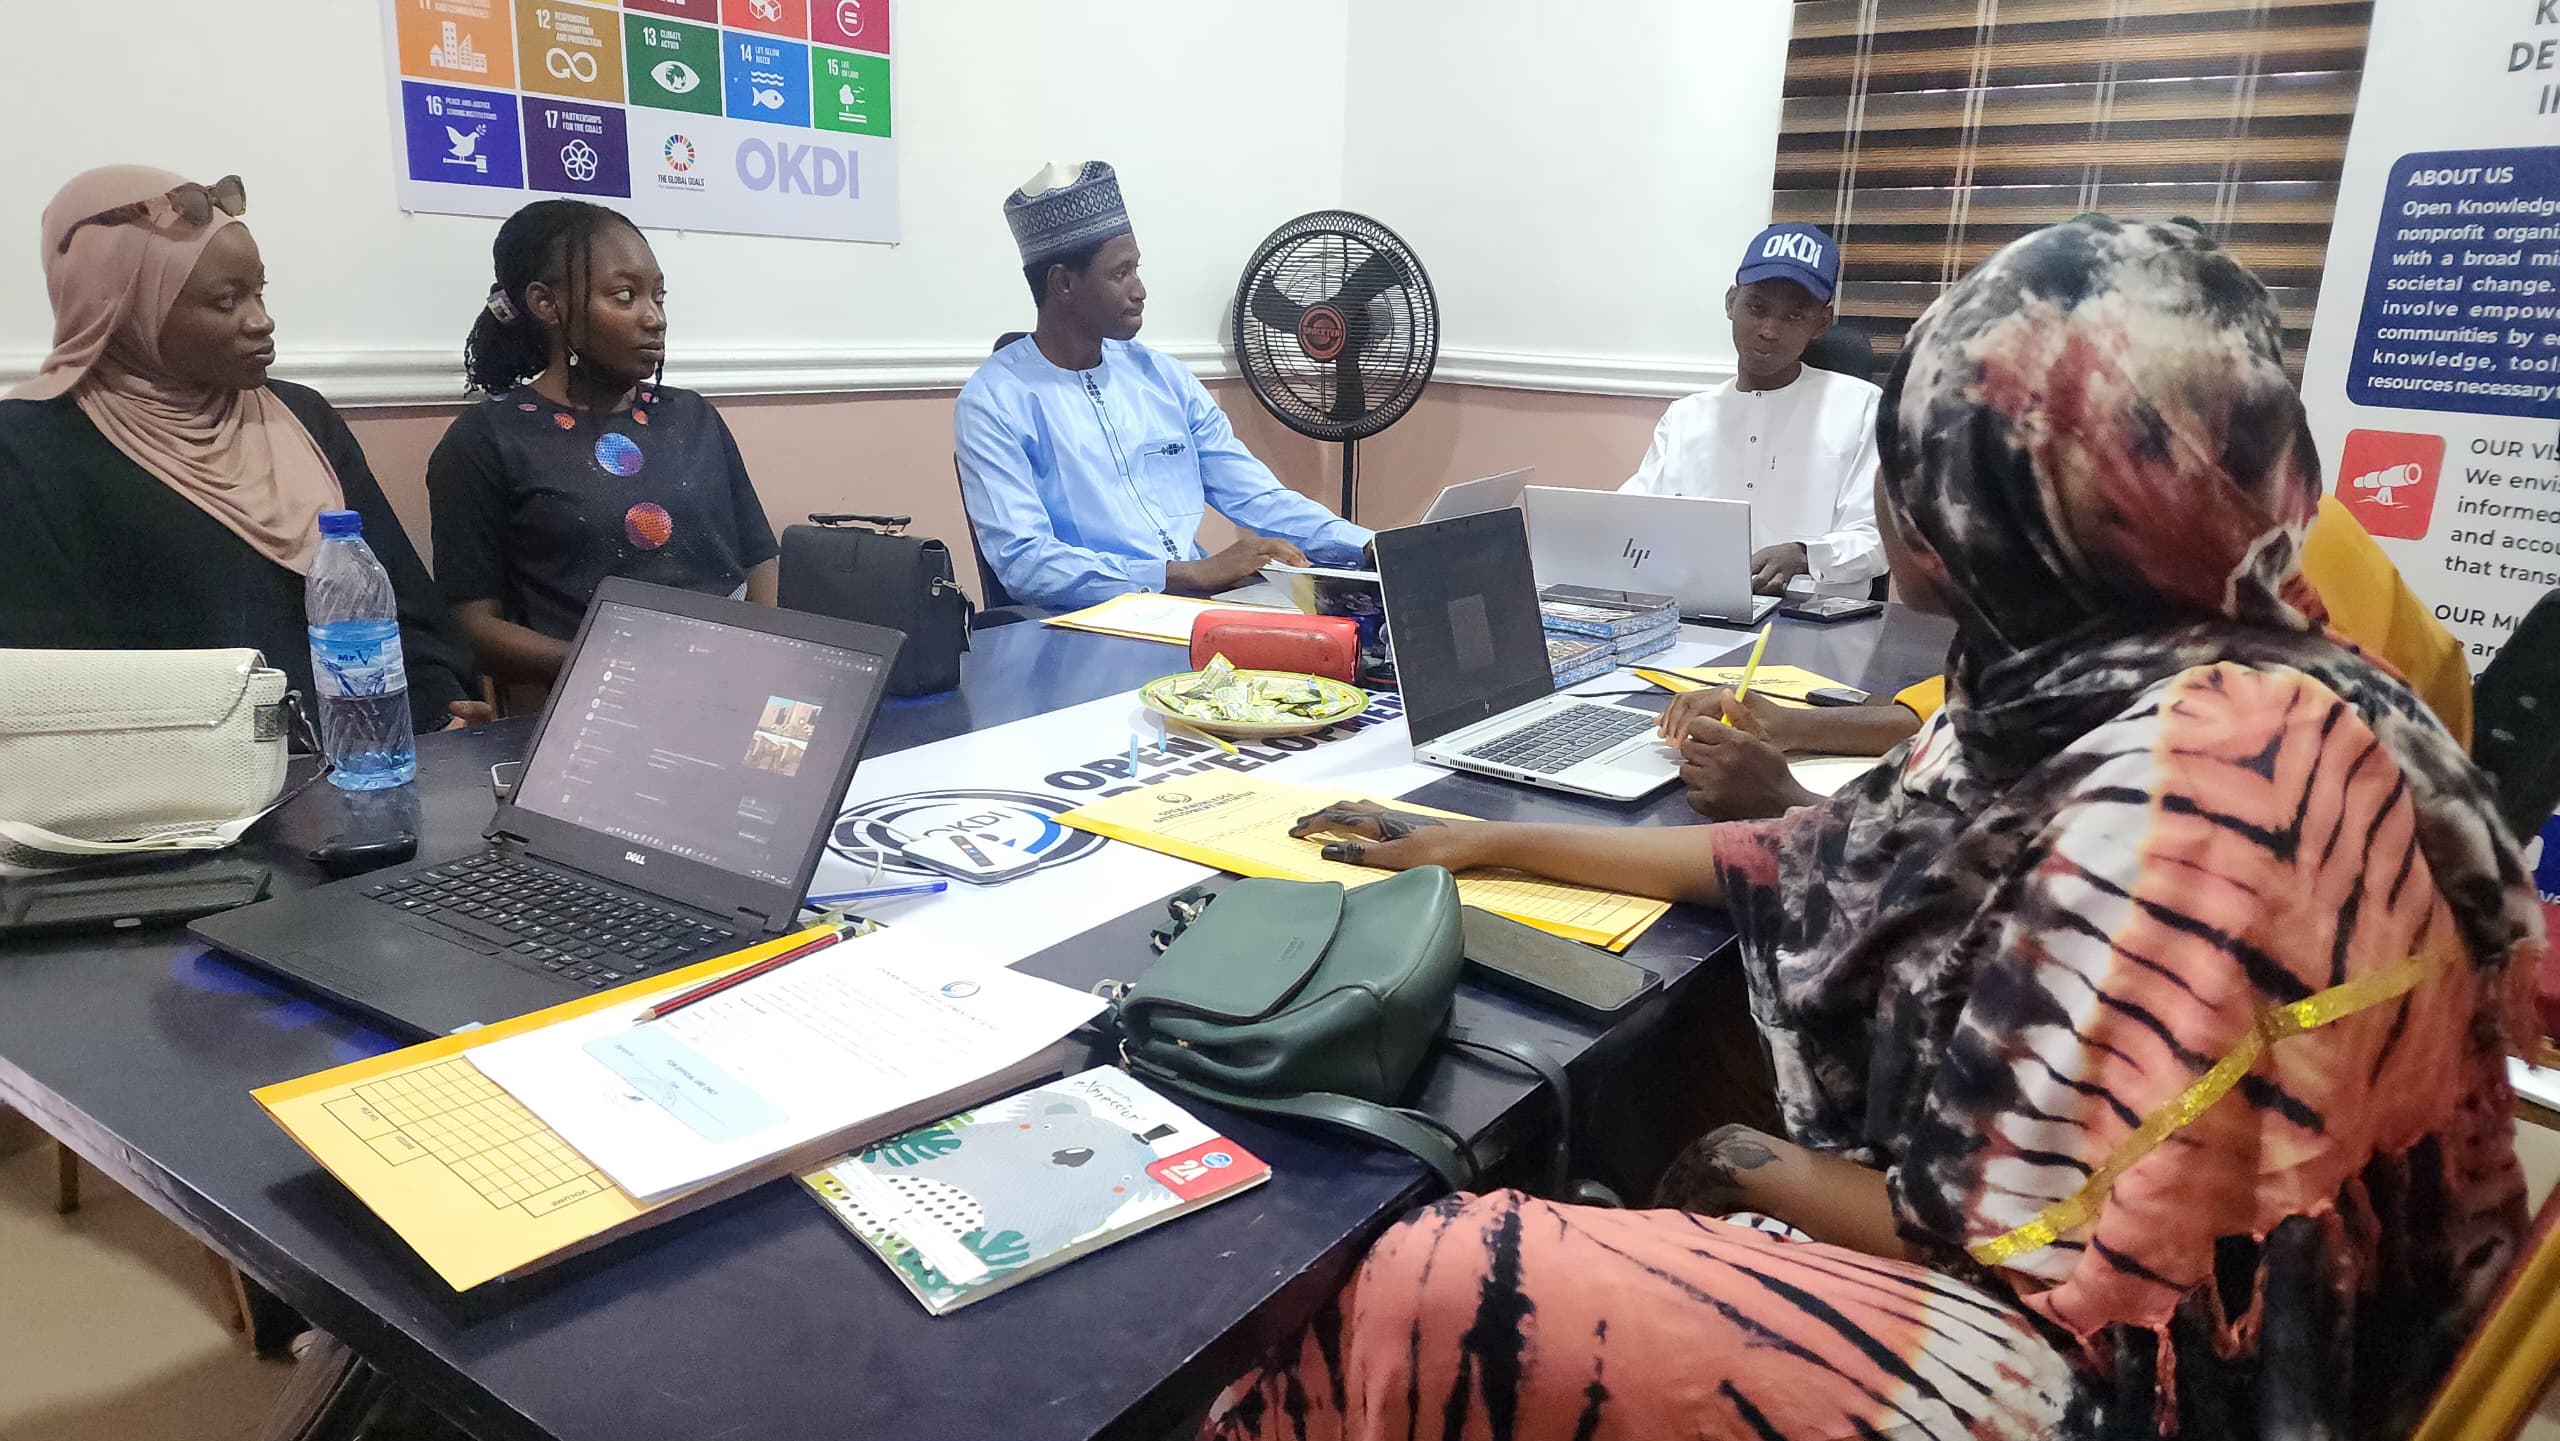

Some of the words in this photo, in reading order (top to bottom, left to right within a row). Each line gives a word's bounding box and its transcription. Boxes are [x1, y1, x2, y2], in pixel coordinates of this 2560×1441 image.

[536, 8, 550, 29] 12
[643, 27, 656, 46] 13
[660, 29, 682, 41] CLIMATE
[661, 40, 679, 50] ACTION
[740, 44, 752, 62] 14
[827, 58, 839, 76] 15
[426, 95, 443, 116] 16
[545, 110, 558, 129] 17
[562, 111, 602, 124] PARTNERSHIPS
[563, 122, 574, 131] FOR
[575, 123, 585, 132] THE
[585, 125, 602, 135] GOALS
[735, 137, 859, 199] OKDI
[2407, 168, 2482, 187] ABOUT
[2485, 166, 2514, 184] US
[658, 174, 668, 184] THE
[668, 176, 687, 185] GLOBAL
[688, 177, 705, 187] GOALS
[2403, 201, 2452, 218] Open
[2397, 224, 2485, 243] nonprofit
[2494, 223, 2560, 243] organi
[2393, 249, 2432, 266] with
[2441, 253, 2454, 266] a
[2463, 249, 2522, 266] broad
[2530, 250, 2560, 267] mi
[2386, 275, 2463, 291] societal
[2472, 276, 2557, 296] change.
[2382, 300, 2459, 316] involve
[2377, 327, 2498, 343] communities
[2507, 328, 2534, 348] by
[2372, 349, 2497, 371] knowledge,
[2509, 355, 2560, 372] tool
[2368, 376, 2454, 392] resources
[2455, 380, 2555, 401] necessary
[2471, 438, 2523, 458] OUR
[2466, 468, 2502, 486] We
[2509, 474, 2560, 492] envi
[2450, 529, 2496, 546] and
[2445, 555, 2492, 576] that
[2499, 563, 2560, 586] trans
[2435, 604, 2486, 626] OUR
[624, 851, 646, 865] DELL
